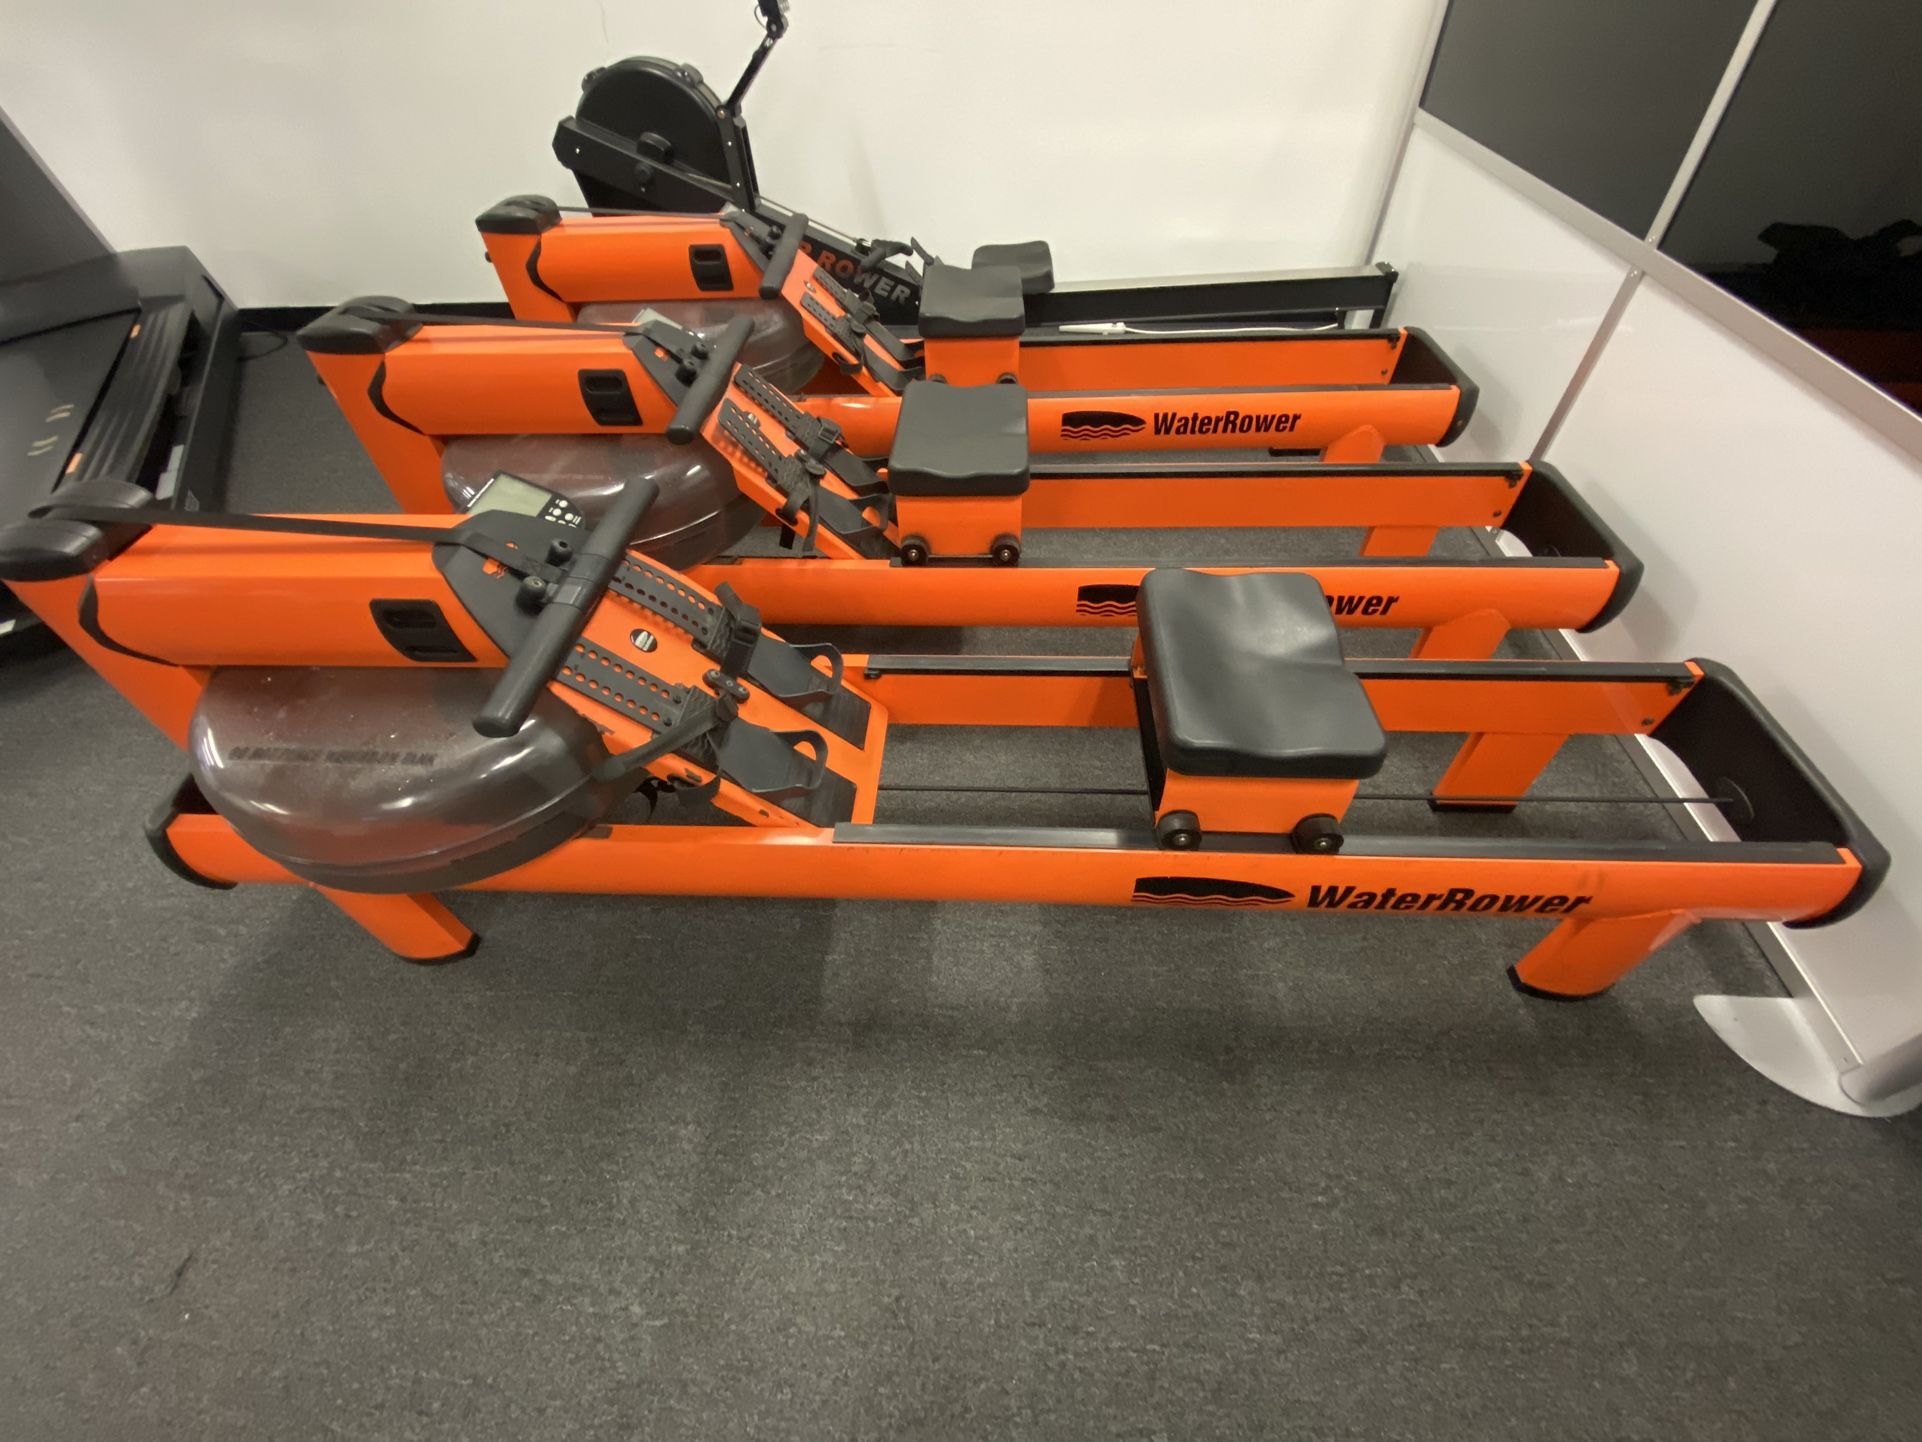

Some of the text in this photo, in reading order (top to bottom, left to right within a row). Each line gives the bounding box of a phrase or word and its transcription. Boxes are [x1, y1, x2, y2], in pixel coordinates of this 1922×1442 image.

[817, 249, 911, 303] ROWER
[1153, 410, 1302, 436] WaterRower
[1306, 884, 1594, 914] WaterRower
